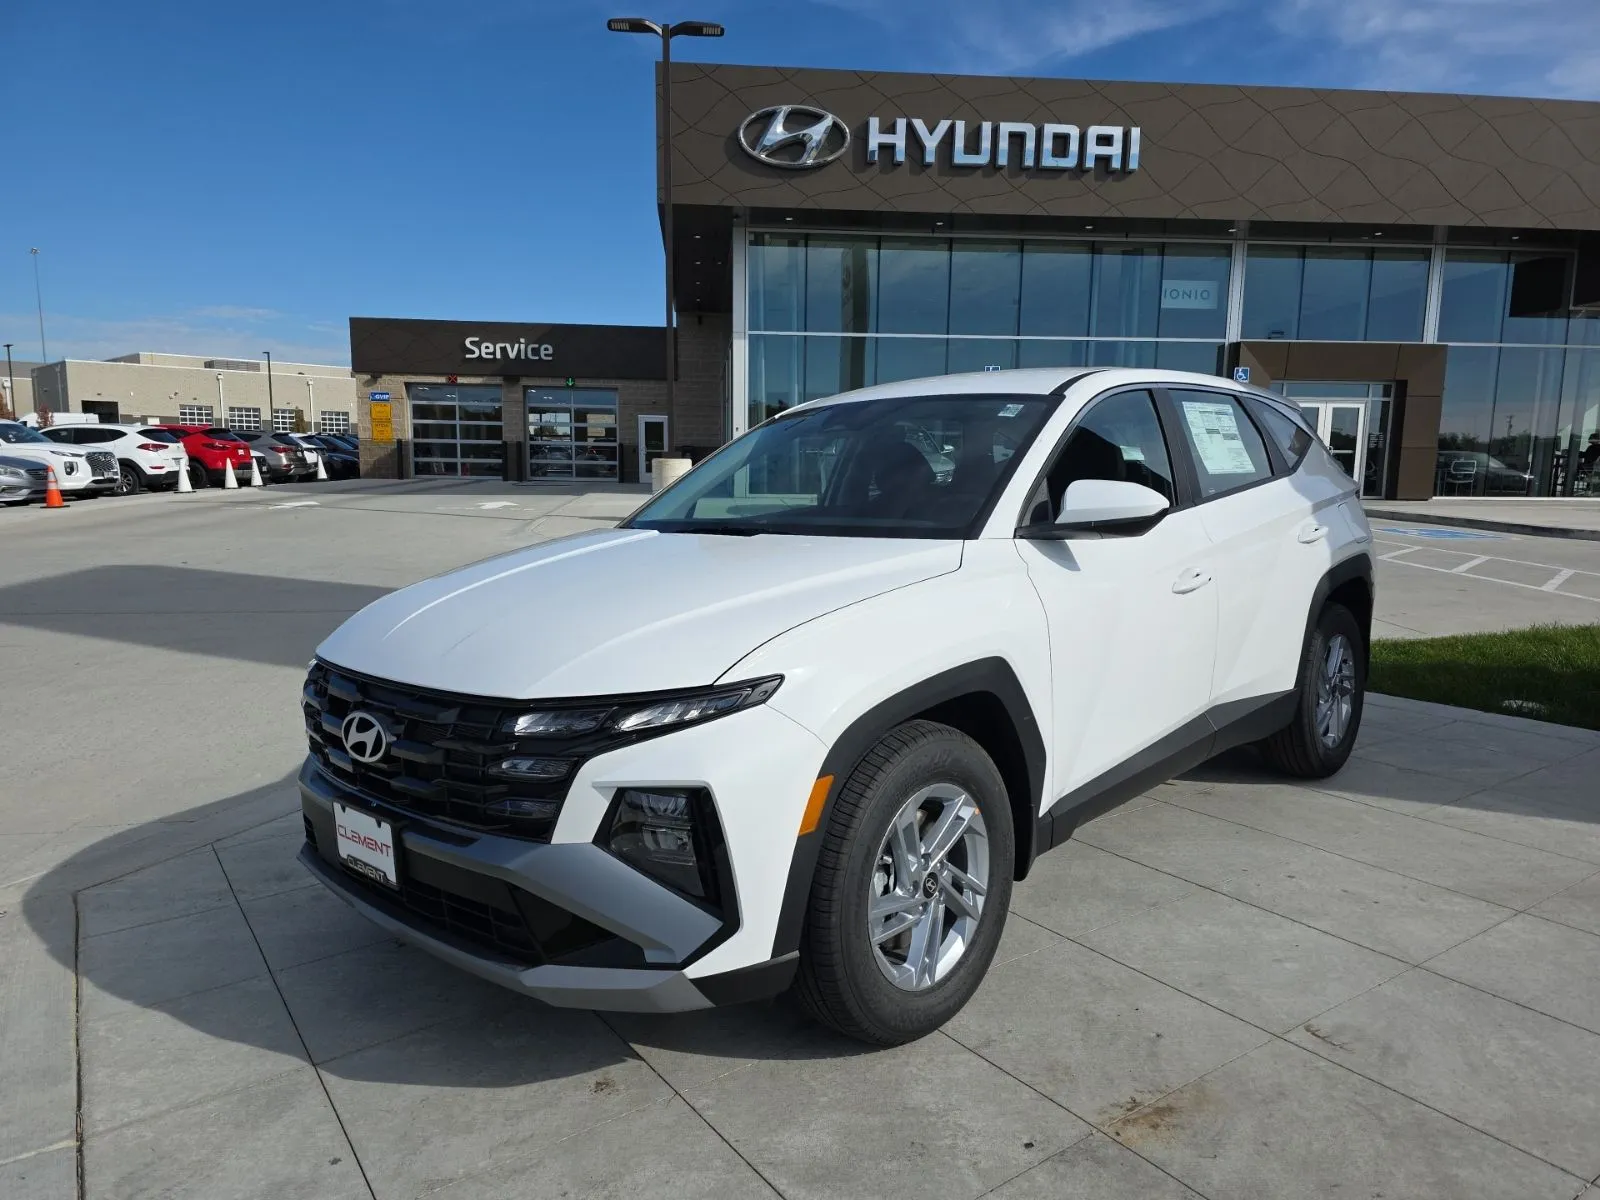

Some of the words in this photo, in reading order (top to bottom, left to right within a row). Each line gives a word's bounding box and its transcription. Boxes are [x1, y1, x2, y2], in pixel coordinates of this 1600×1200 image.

[866, 116, 1141, 172] HYUNDAI
[464, 336, 553, 361] Service
[337, 824, 392, 857] CLEMENT
